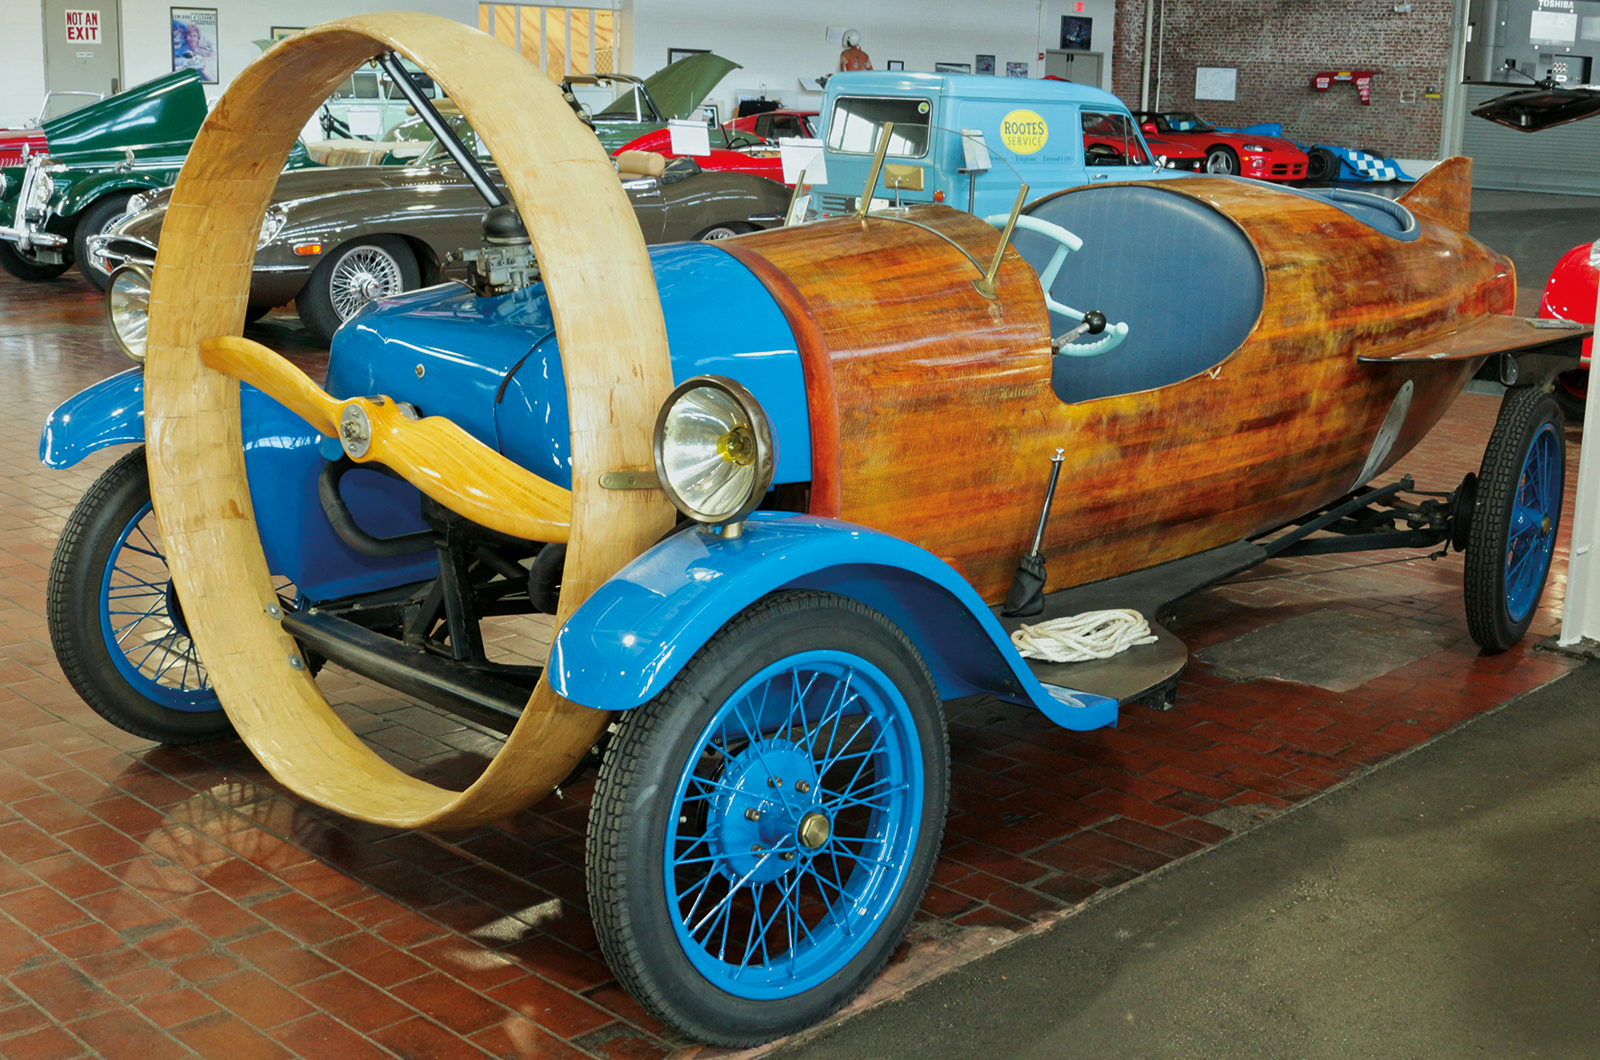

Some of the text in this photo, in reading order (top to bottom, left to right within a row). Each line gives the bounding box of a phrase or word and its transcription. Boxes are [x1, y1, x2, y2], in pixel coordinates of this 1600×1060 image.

[1538, 0, 1574, 9] TOSHIBA
[66, 12, 98, 26] NOT AN
[67, 26, 98, 40] EXIT
[1004, 121, 1044, 135] ROOTES
[1007, 136, 1042, 146] SERVICE
